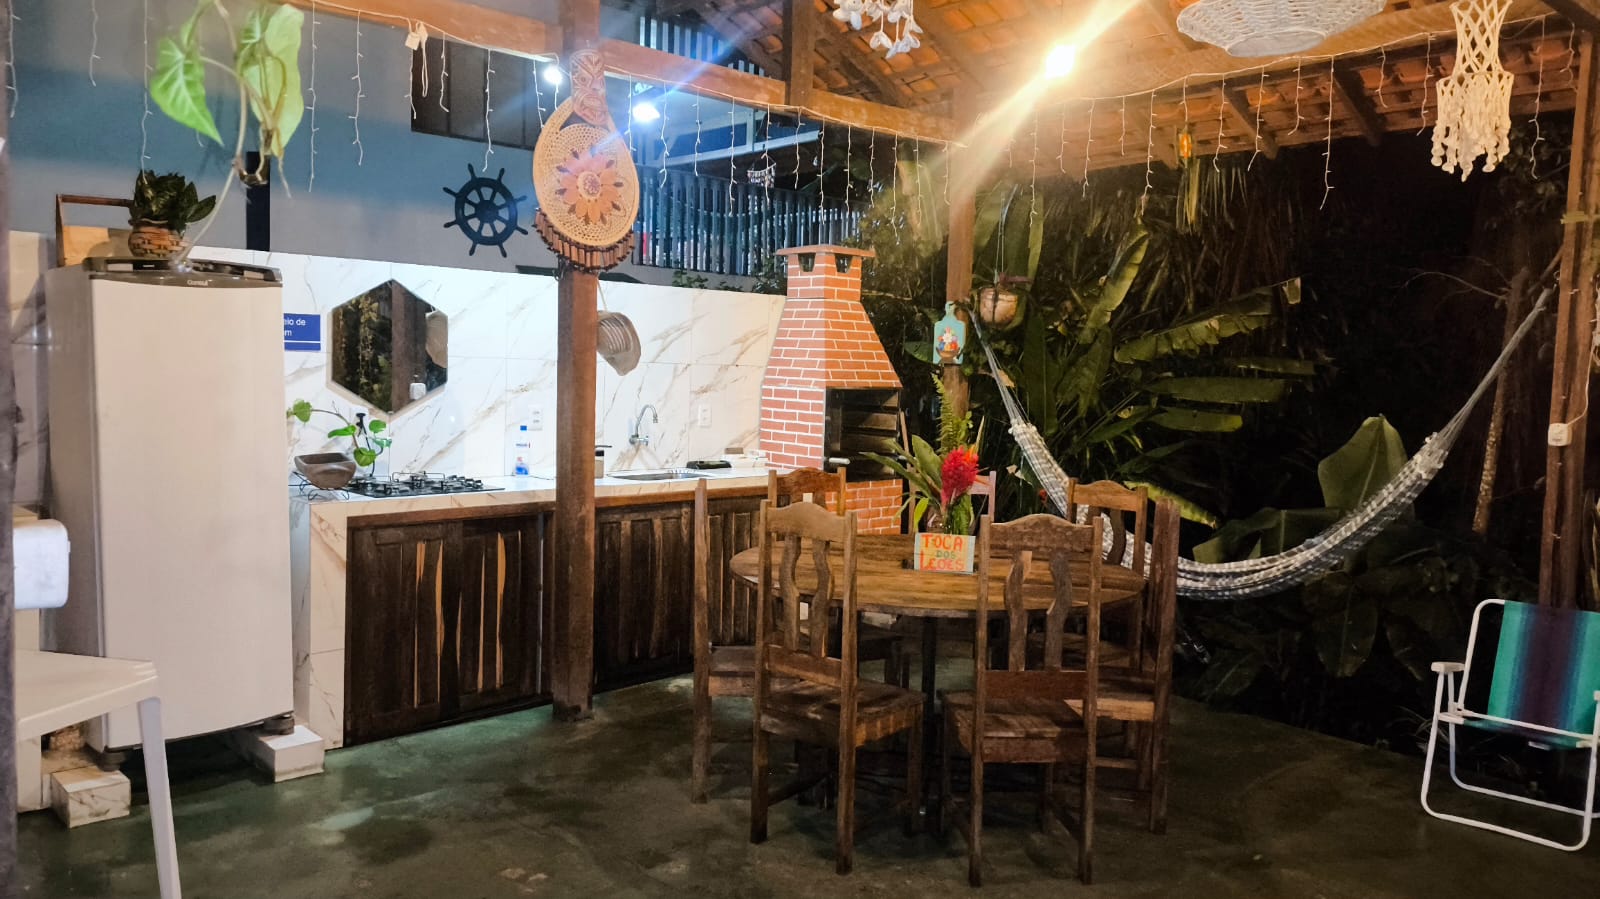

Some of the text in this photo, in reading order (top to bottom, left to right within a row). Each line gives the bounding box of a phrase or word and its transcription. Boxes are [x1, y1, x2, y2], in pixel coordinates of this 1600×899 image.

[295, 318, 306, 326] de
[921, 533, 964, 552] TOCA
[936, 550, 957, 560] DOS
